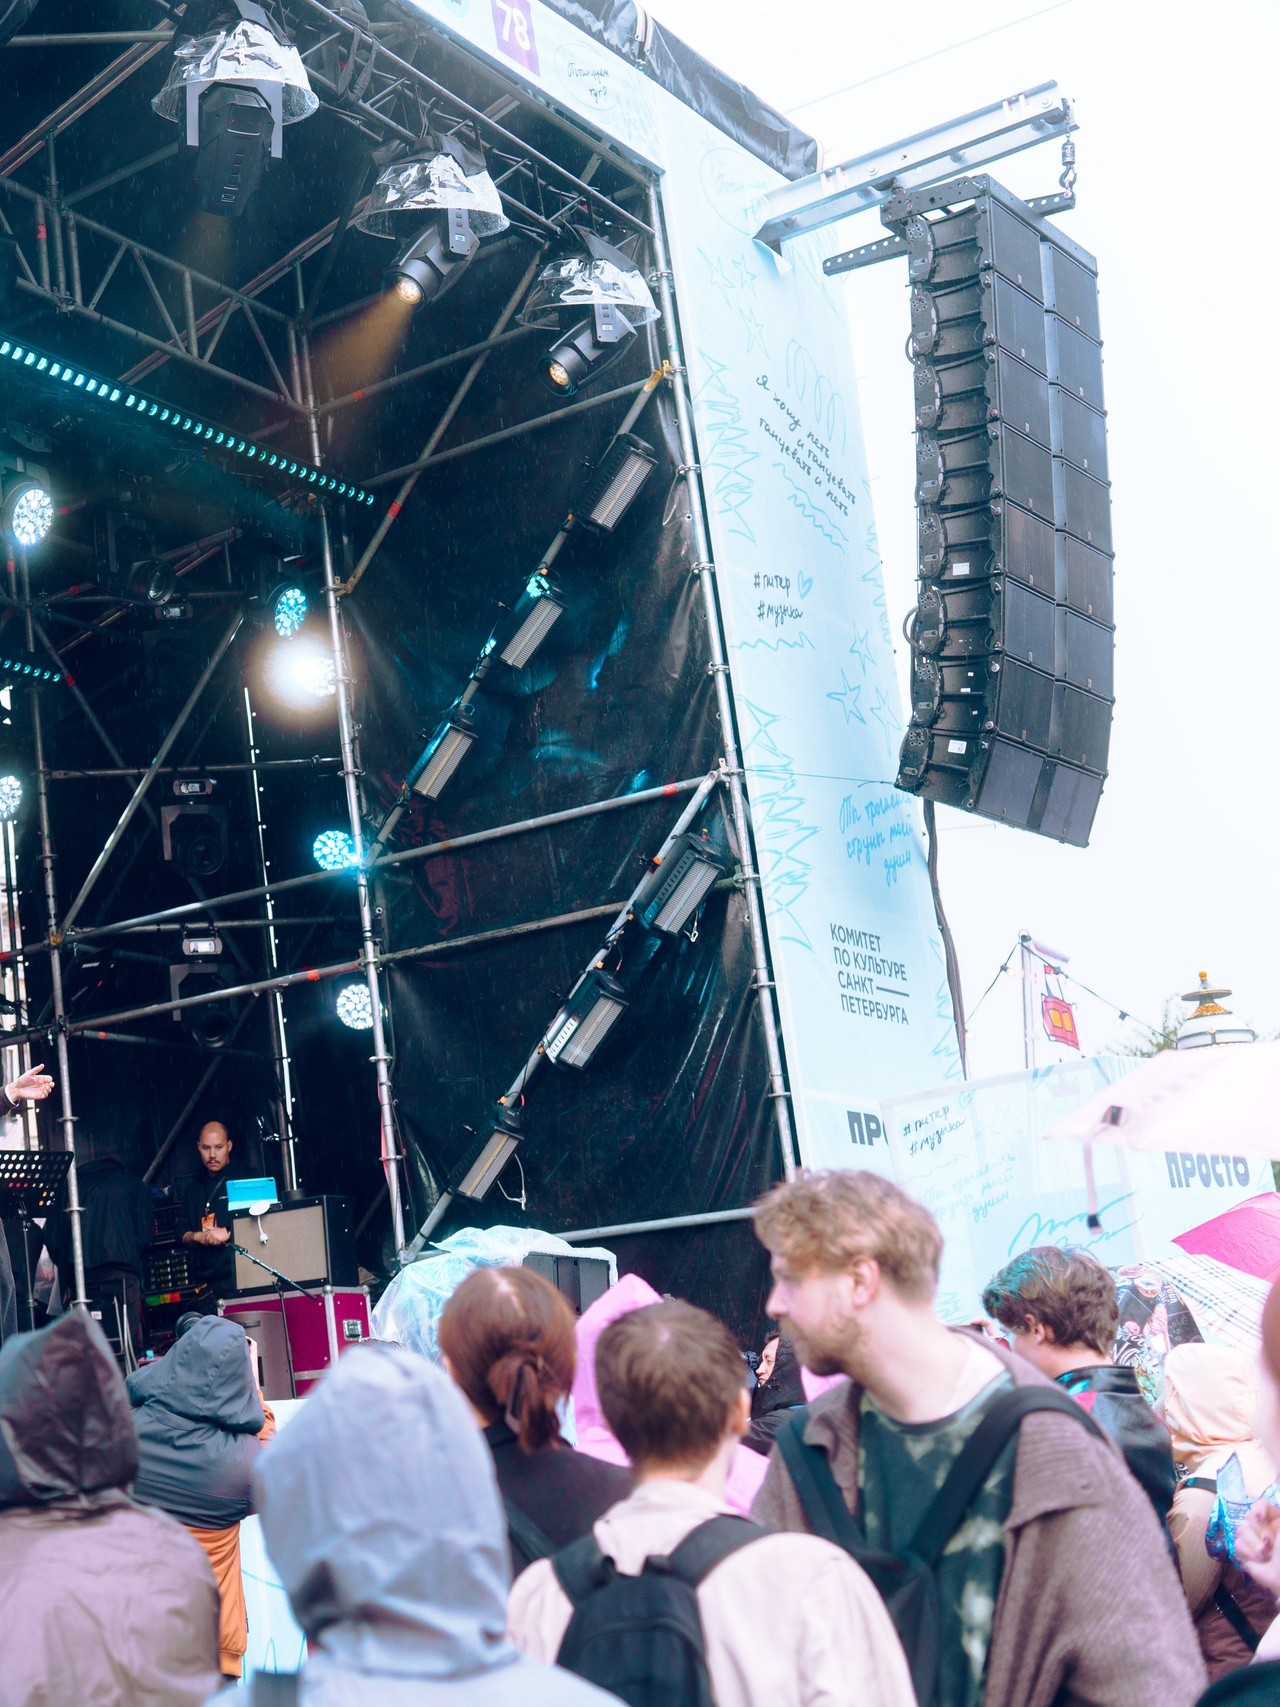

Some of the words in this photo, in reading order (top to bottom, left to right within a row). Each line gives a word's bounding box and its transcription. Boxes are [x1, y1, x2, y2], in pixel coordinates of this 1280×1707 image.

[496, 0, 531, 51] 78
[773, 393, 801, 432] хочу
[807, 431, 830, 459] петь
[759, 418, 811, 476] танцевать
[815, 477, 822, 487] и
[826, 490, 848, 516] петь
[797, 439, 804, 450] и
[808, 450, 856, 504] танцевать
[830, 923, 881, 952] КОМИТЕТ
[833, 946, 851, 967] ПО
[853, 954, 907, 981] КУЛЬТУРЕ
[841, 993, 909, 1025] ПЕТЕРБУРГА
[847, 1110, 889, 1146] ПР
[1164, 1151, 1250, 1188] ПРОСТО
